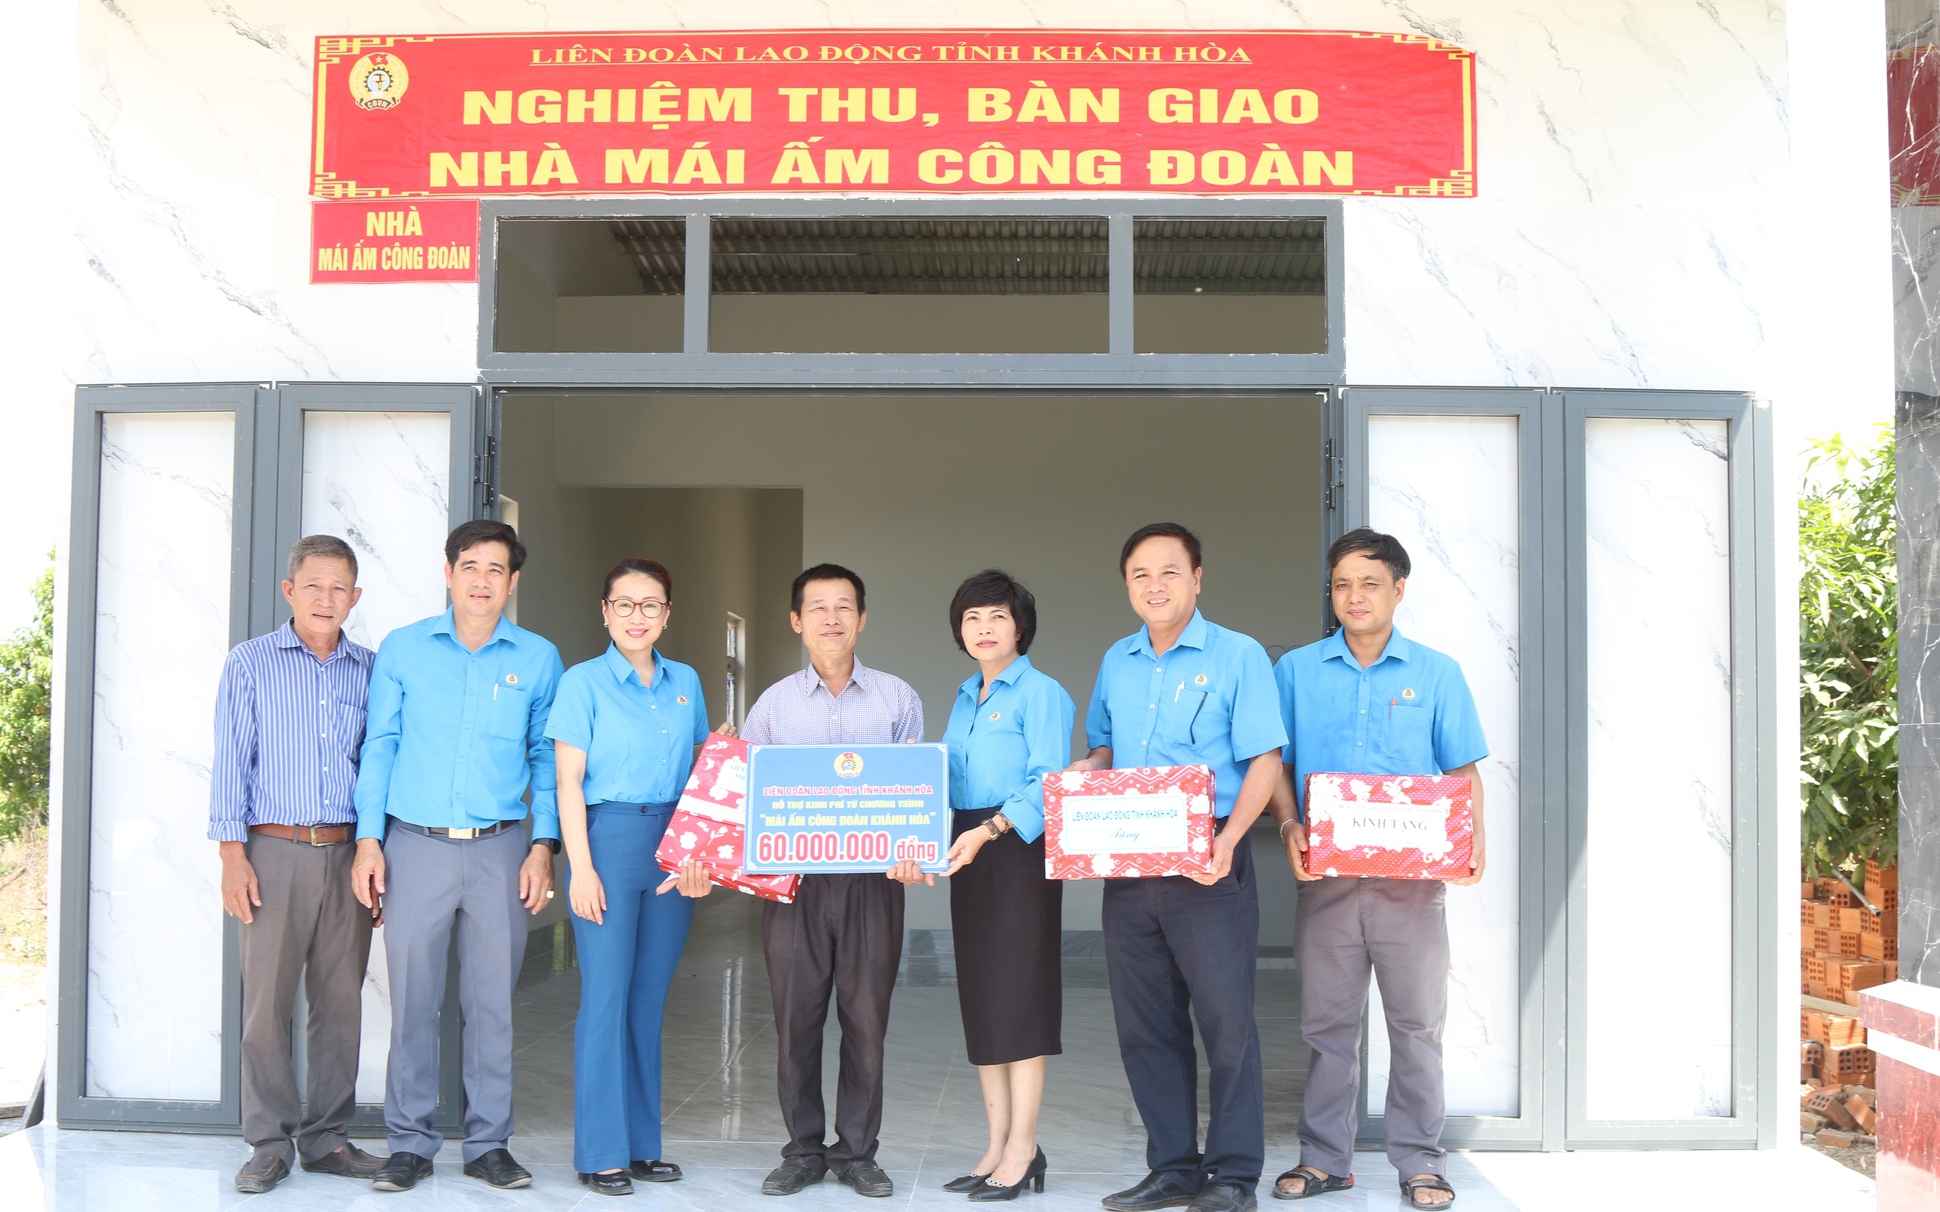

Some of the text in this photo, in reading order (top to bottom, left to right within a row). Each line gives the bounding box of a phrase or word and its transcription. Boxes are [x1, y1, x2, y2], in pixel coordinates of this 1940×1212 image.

[531, 41, 1253, 65] LIÊN ĐOÀN LAO ĐỘNG TỈNH KHÁNH HÒA
[462, 80, 1319, 130] NGHIỆM THU, BÀN GIAO
[428, 136, 1354, 188] NHÀ MÁI ẤM CÔNG ĐOÀN
[366, 205, 423, 237] NHÀ
[318, 239, 470, 271] MÁI ẤM CÔNG ĐOÀN
[763, 784, 933, 797] LIÊN ĐOÀN LAO ĐỘNG TỈNH KHÁNH HÒA
[787, 800, 804, 810] TRỢ
[806, 801, 827, 809] KINH
[1102, 811, 1113, 820] LAO
[788, 813, 805, 826] ẤM
[808, 813, 837, 826] CÔNG
[839, 813, 868, 826] ĐOÀN
[870, 813, 906, 825] KHÁNH
[1353, 814, 1386, 828] KÍNH
[758, 832, 936, 862] 60.000.000 đồng
